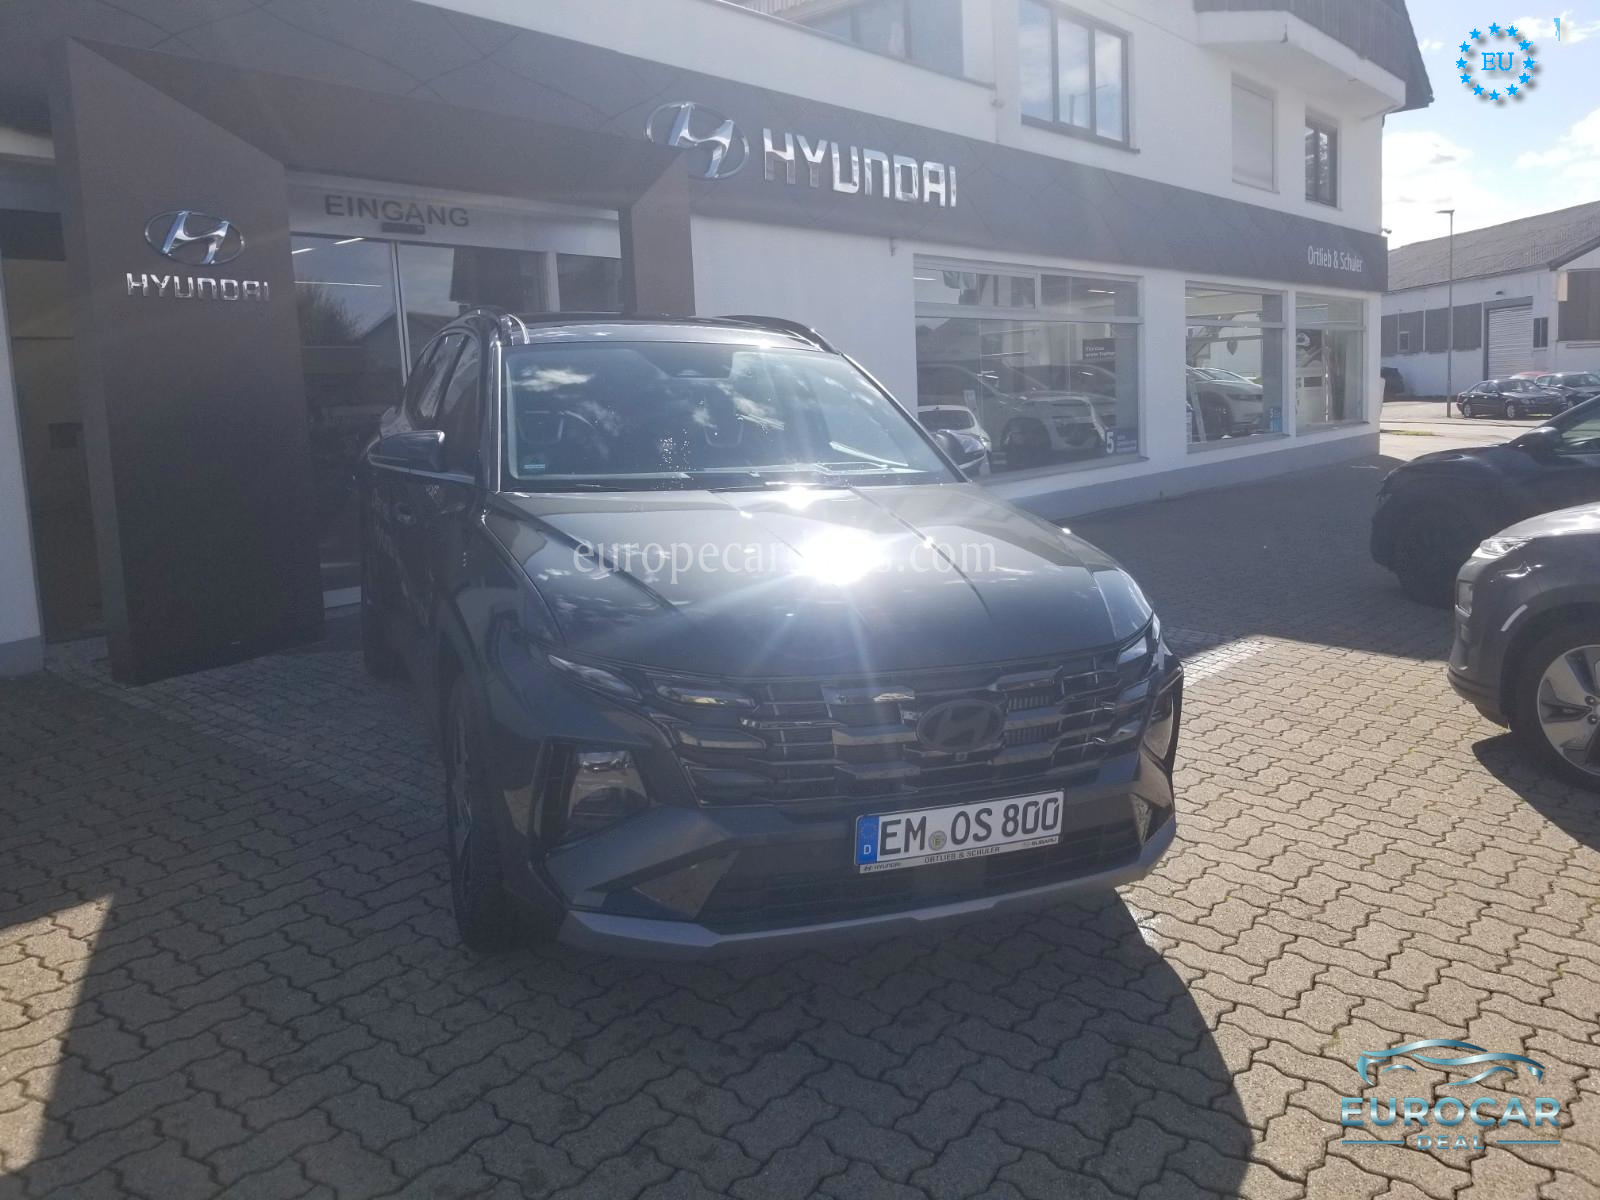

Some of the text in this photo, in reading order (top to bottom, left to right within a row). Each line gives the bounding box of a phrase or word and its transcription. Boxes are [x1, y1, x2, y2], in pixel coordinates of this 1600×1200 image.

[763, 127, 957, 207] HYUNDAI
[324, 194, 469, 227] EINGANG
[1307, 246, 1332, 268] Ortlieb
[1333, 250, 1339, 269] &
[126, 272, 269, 301] HYUNDAI
[879, 797, 1060, 856] EM OS 800
[863, 844, 872, 856] D
